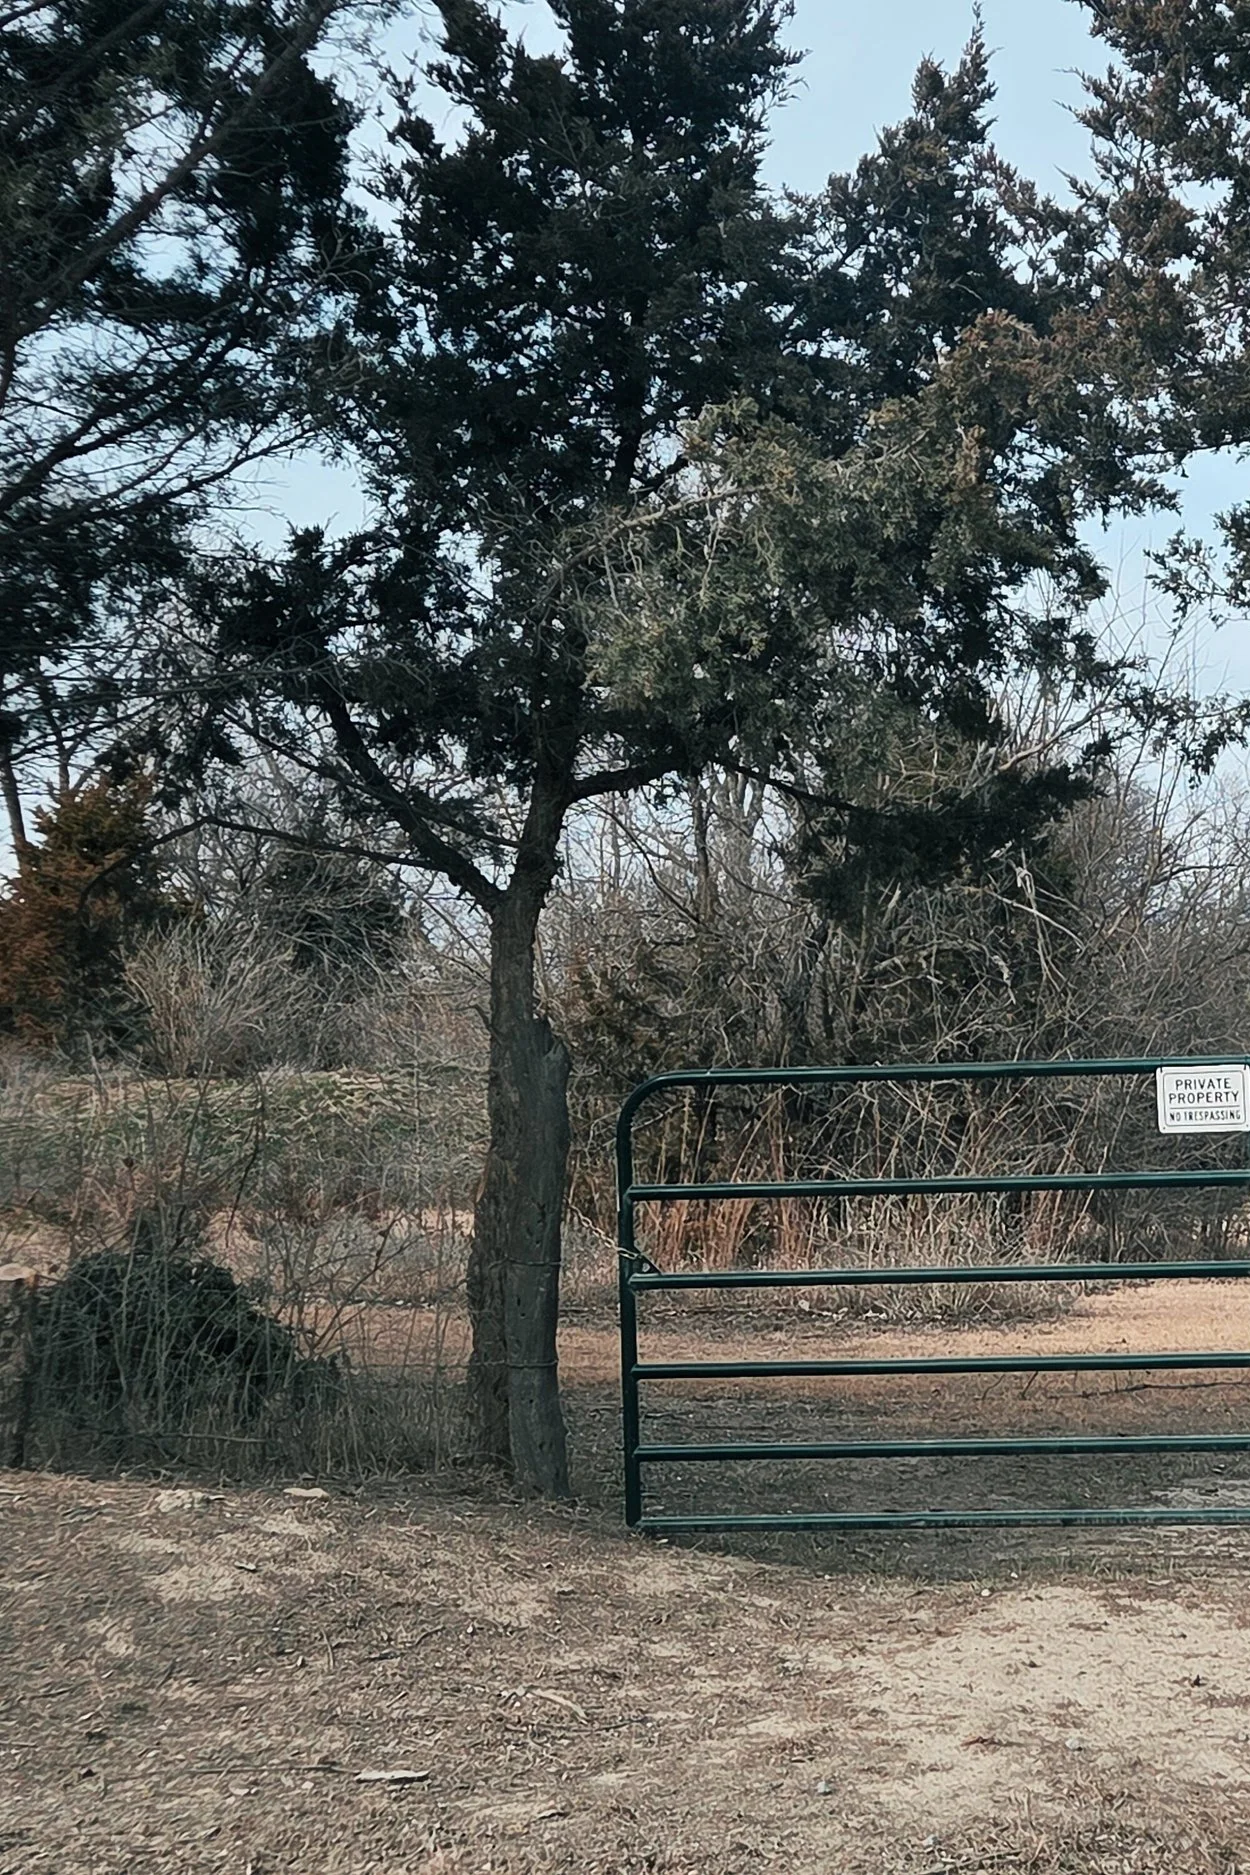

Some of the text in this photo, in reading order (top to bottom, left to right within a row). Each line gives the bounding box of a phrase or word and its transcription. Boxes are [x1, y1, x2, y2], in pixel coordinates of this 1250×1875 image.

[1175, 1078, 1231, 1090] PRIVATE
[1168, 1091, 1239, 1104] PROPERTY
[1169, 1110, 1241, 1121] NO TRESPASSING
